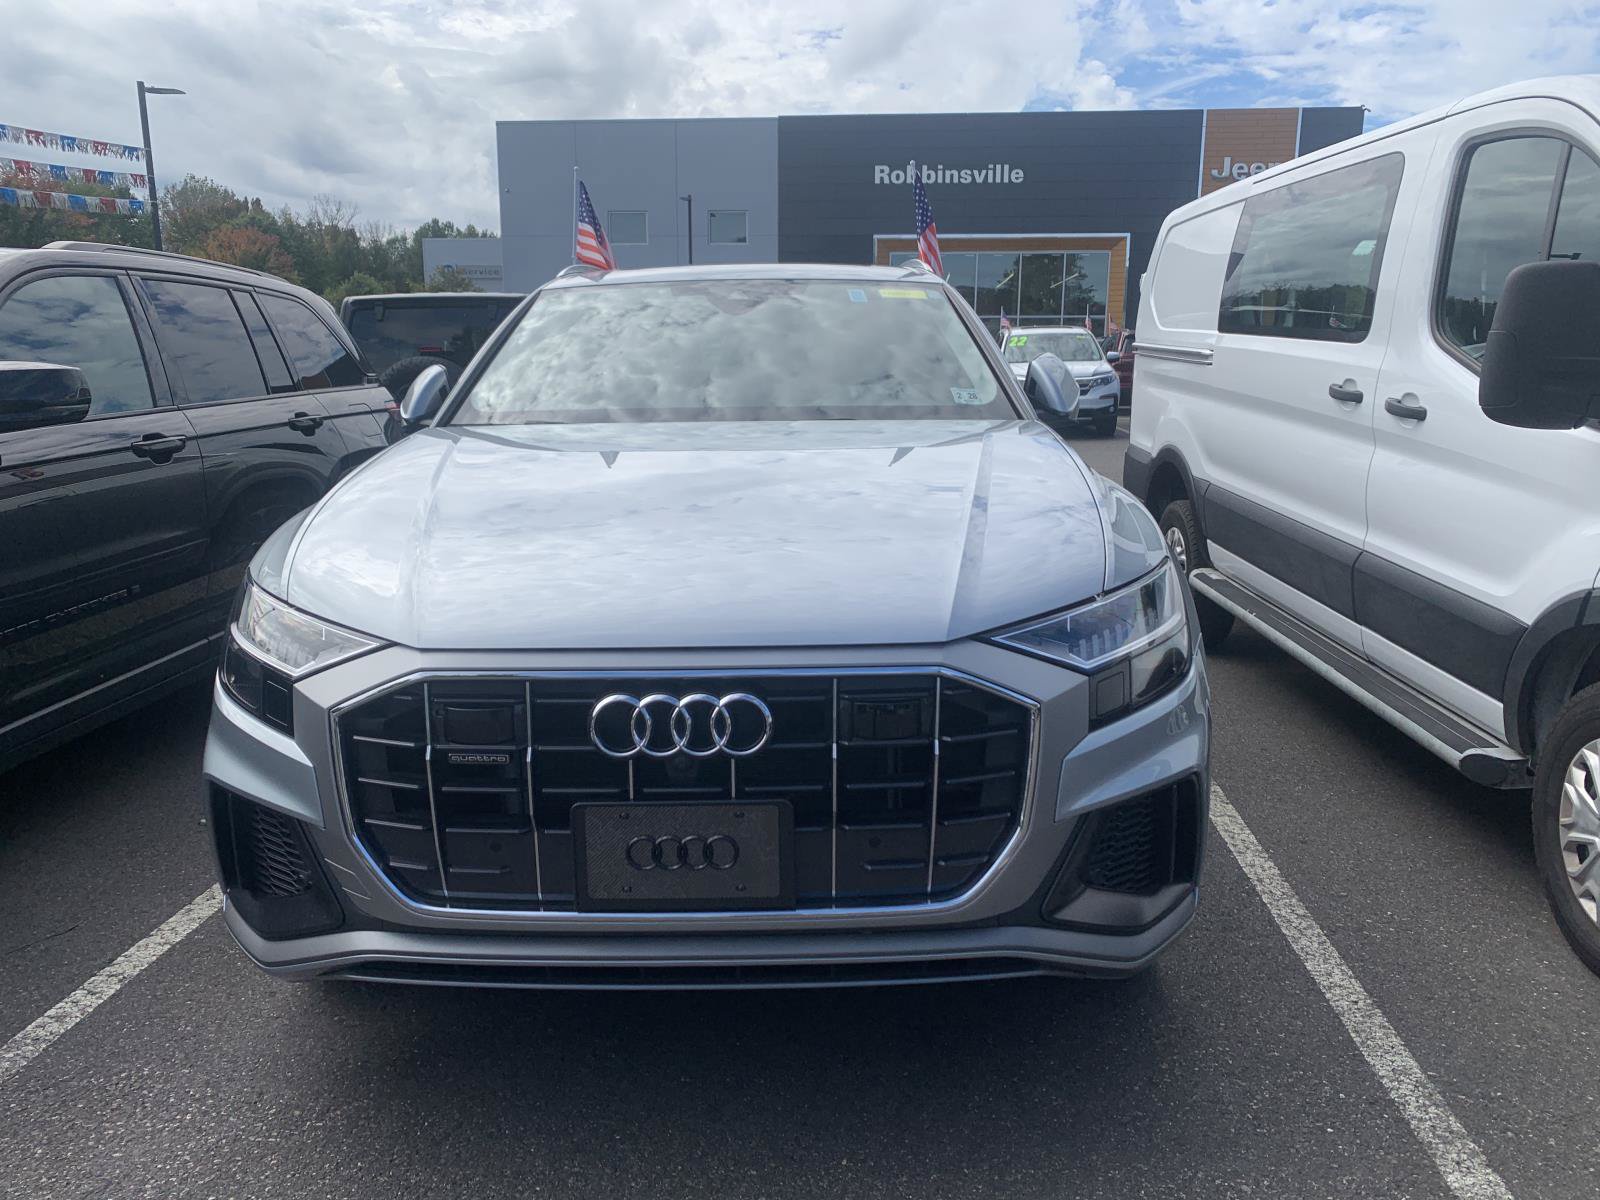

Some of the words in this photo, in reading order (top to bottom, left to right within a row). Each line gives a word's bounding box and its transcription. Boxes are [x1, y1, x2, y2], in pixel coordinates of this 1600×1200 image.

[1211, 156, 1282, 180] Jee
[1009, 336, 1028, 347] 22
[451, 755, 507, 763] quattro
